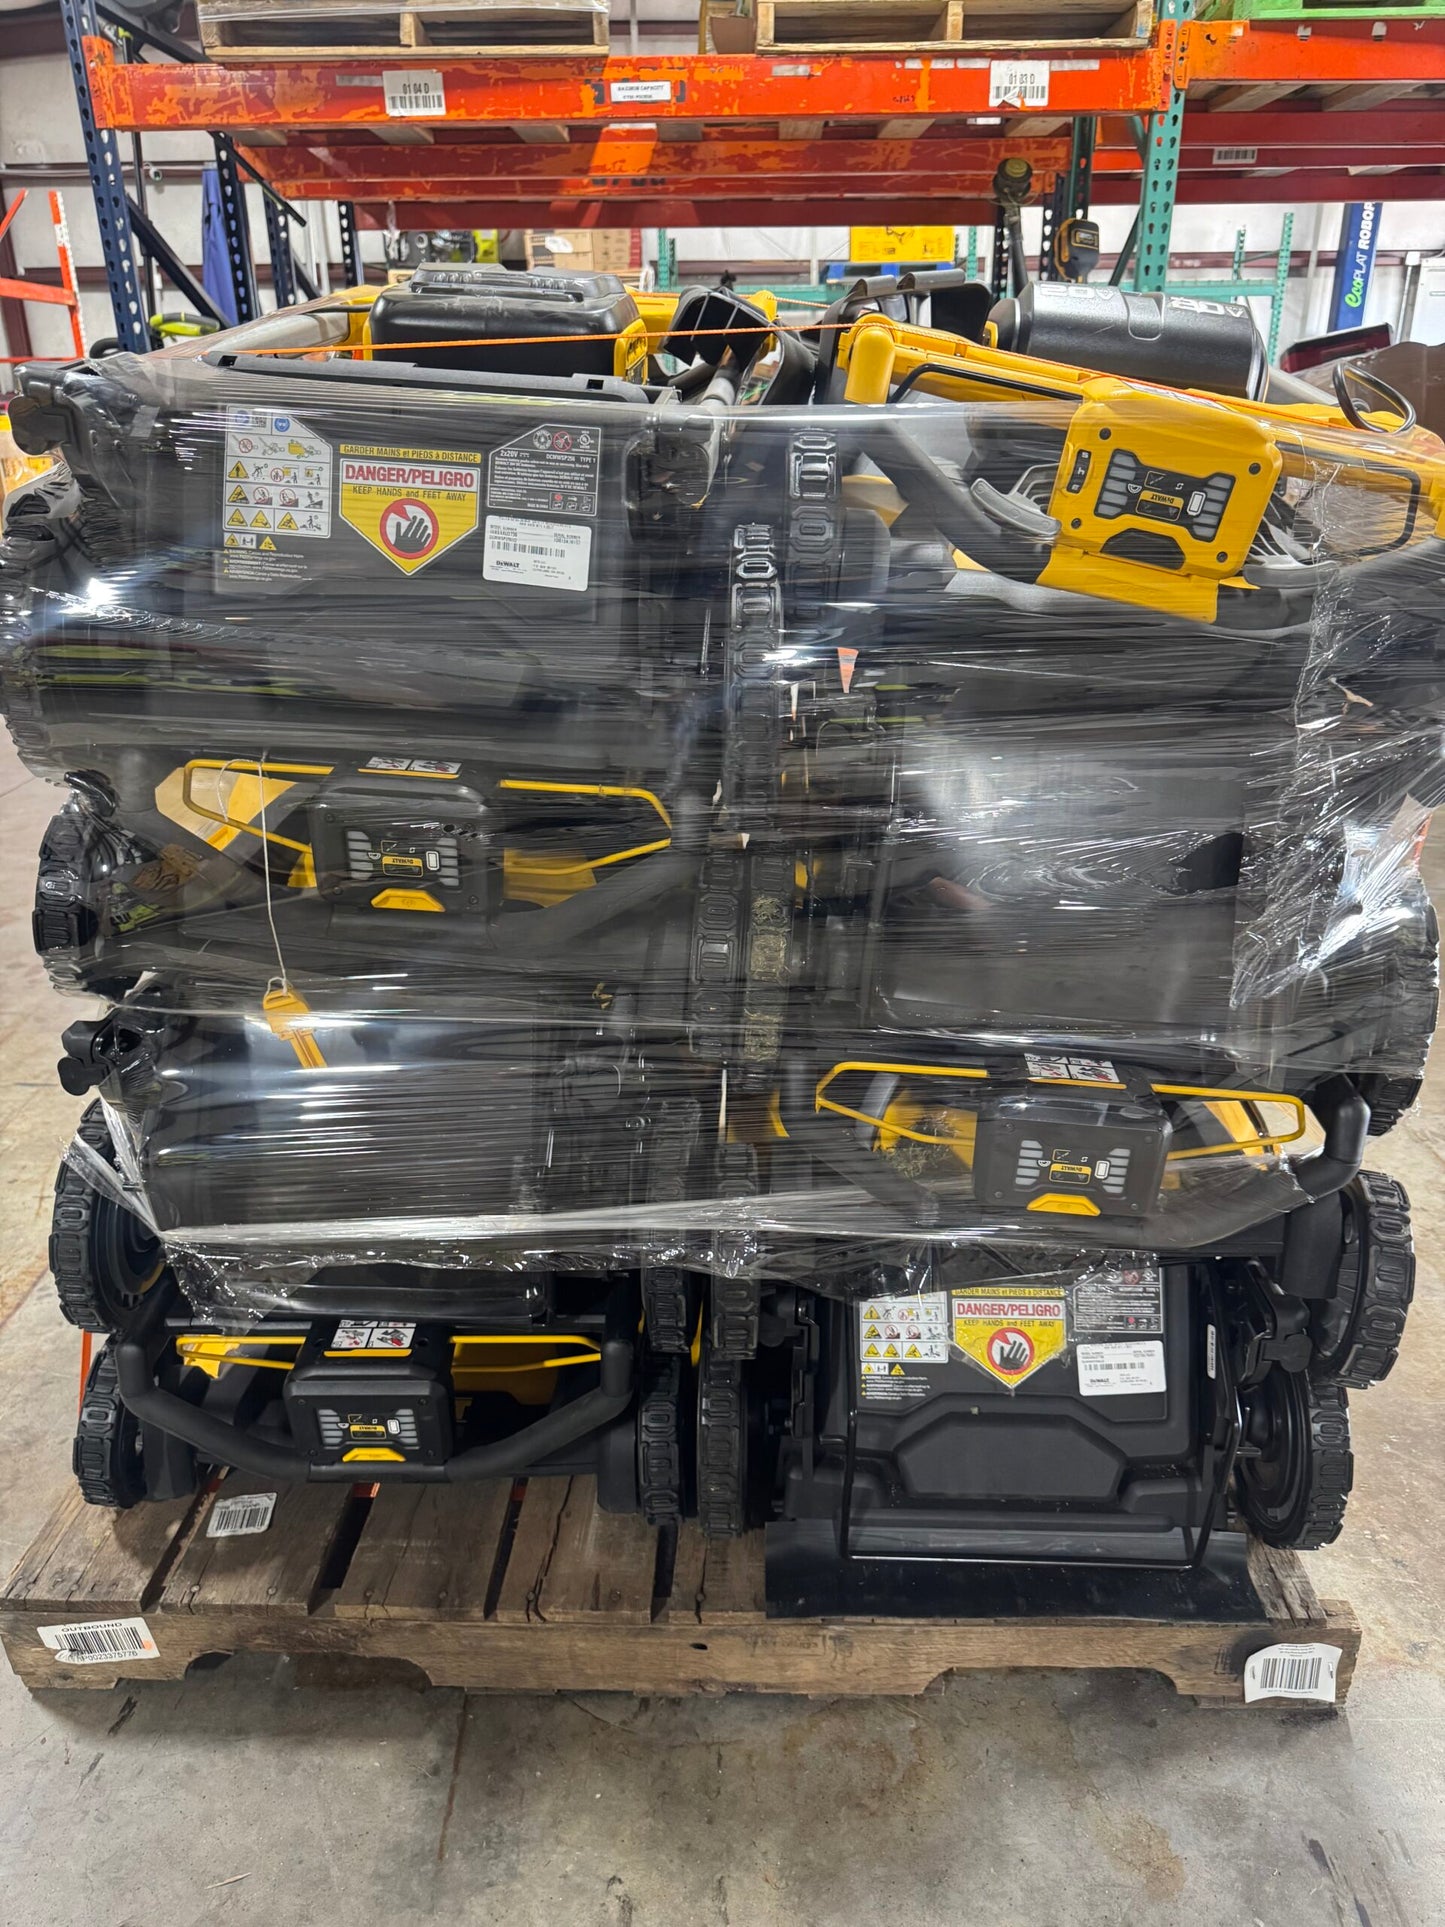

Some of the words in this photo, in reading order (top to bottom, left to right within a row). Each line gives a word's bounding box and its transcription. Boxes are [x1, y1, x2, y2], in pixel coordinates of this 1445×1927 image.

[1358, 201, 1377, 250] ROBOP
[344, 445, 374, 455] GARDER
[377, 447, 401, 457] MAINS
[411, 450, 433, 459] PIEDS
[441, 453, 478, 463] DISTANCE
[345, 464, 474, 488] DANGER/PELIGRO
[352, 486, 373, 494] KEEP
[376, 487, 402, 497] HANDS
[405, 489, 419, 498] and
[422, 490, 441, 500] FEET
[445, 492, 466, 501] AWAY
[957, 1303, 1061, 1317] DANGER/PELIGRO
[61, 1622, 122, 1632] OUTBOUND
